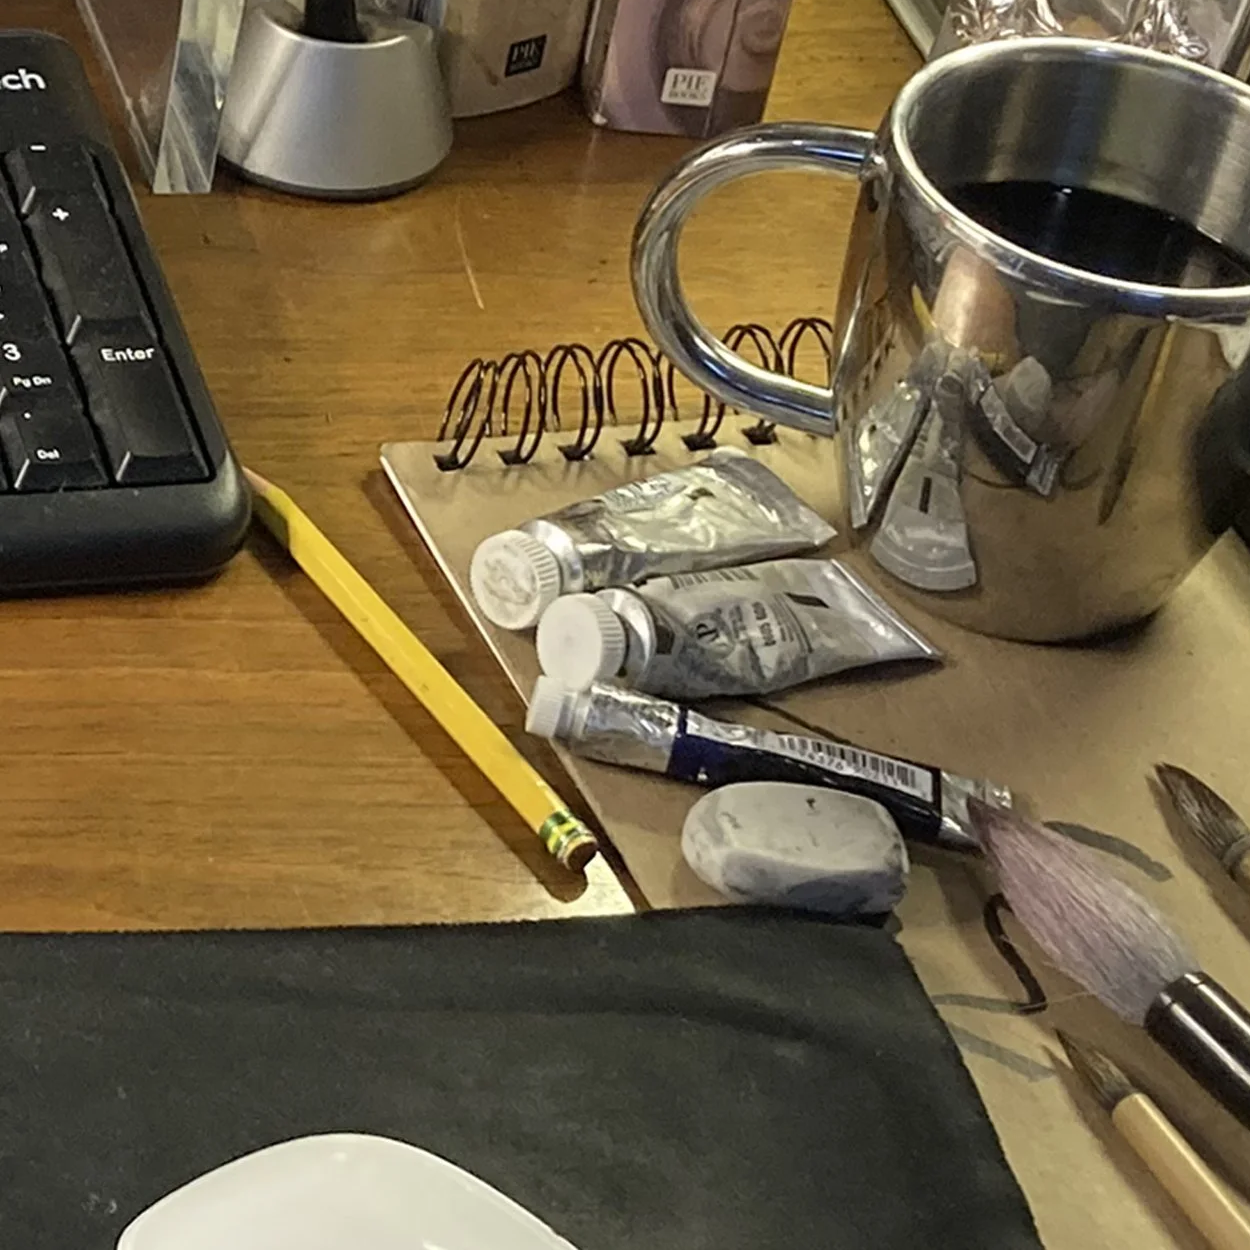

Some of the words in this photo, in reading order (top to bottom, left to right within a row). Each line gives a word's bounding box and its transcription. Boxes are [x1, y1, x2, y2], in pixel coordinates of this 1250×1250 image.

[3, 344, 21, 362] 3
[100, 347, 156, 363] Enter
[37, 449, 60, 462] Del
